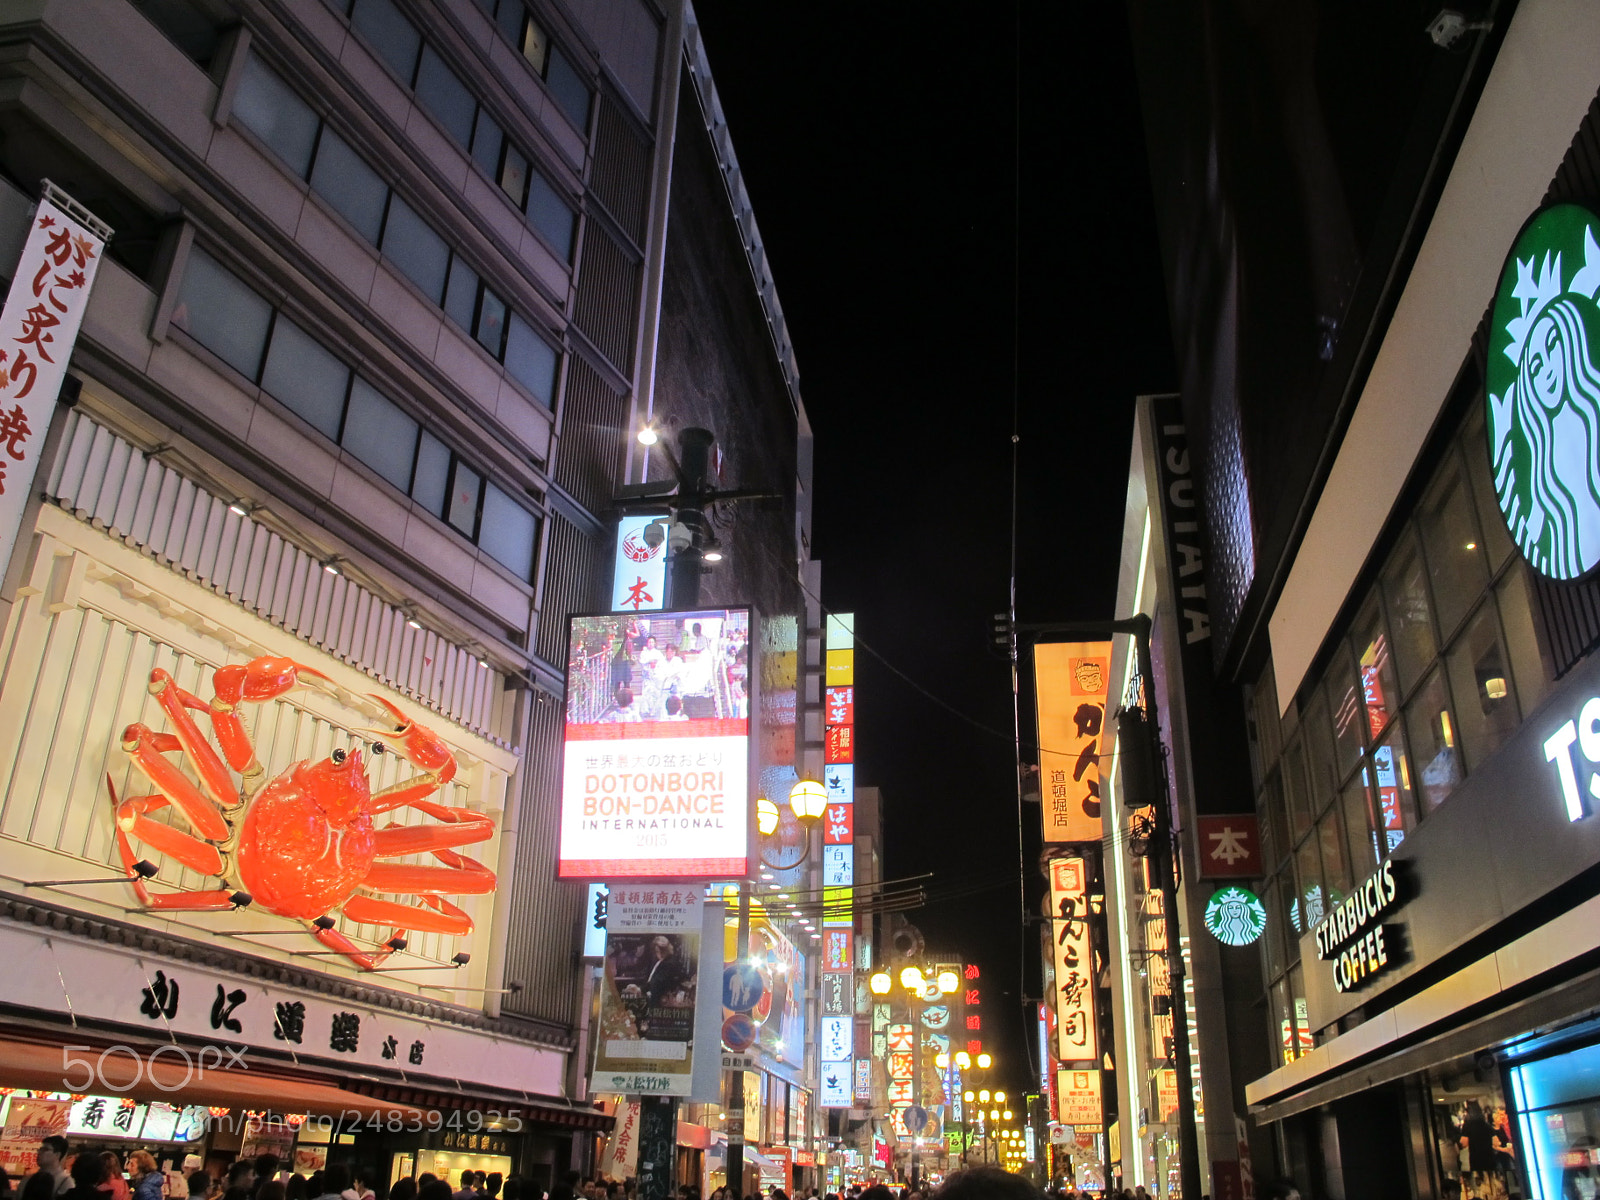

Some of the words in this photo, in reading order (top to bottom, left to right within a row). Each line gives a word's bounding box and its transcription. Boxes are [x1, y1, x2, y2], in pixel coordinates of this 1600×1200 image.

[620, 576, 654, 610] 本
[586, 753, 723, 769] 世界最大の盆おどり
[585, 772, 723, 794] DOTONBORI
[583, 794, 724, 816] BON-DANCE
[1051, 770, 1068, 827] 道頓堀店
[582, 818, 724, 830] INTERNATIONAL
[1208, 827, 1250, 865] 本
[833, 849, 850, 883] 白木屋
[614, 891, 698, 905] 道頓堀商店会
[1316, 859, 1396, 960] STARBUCKS
[1332, 924, 1388, 994] COFFEE
[722, 1057, 753, 1067] 自動車
[823, 1064, 832, 1072] 6F
